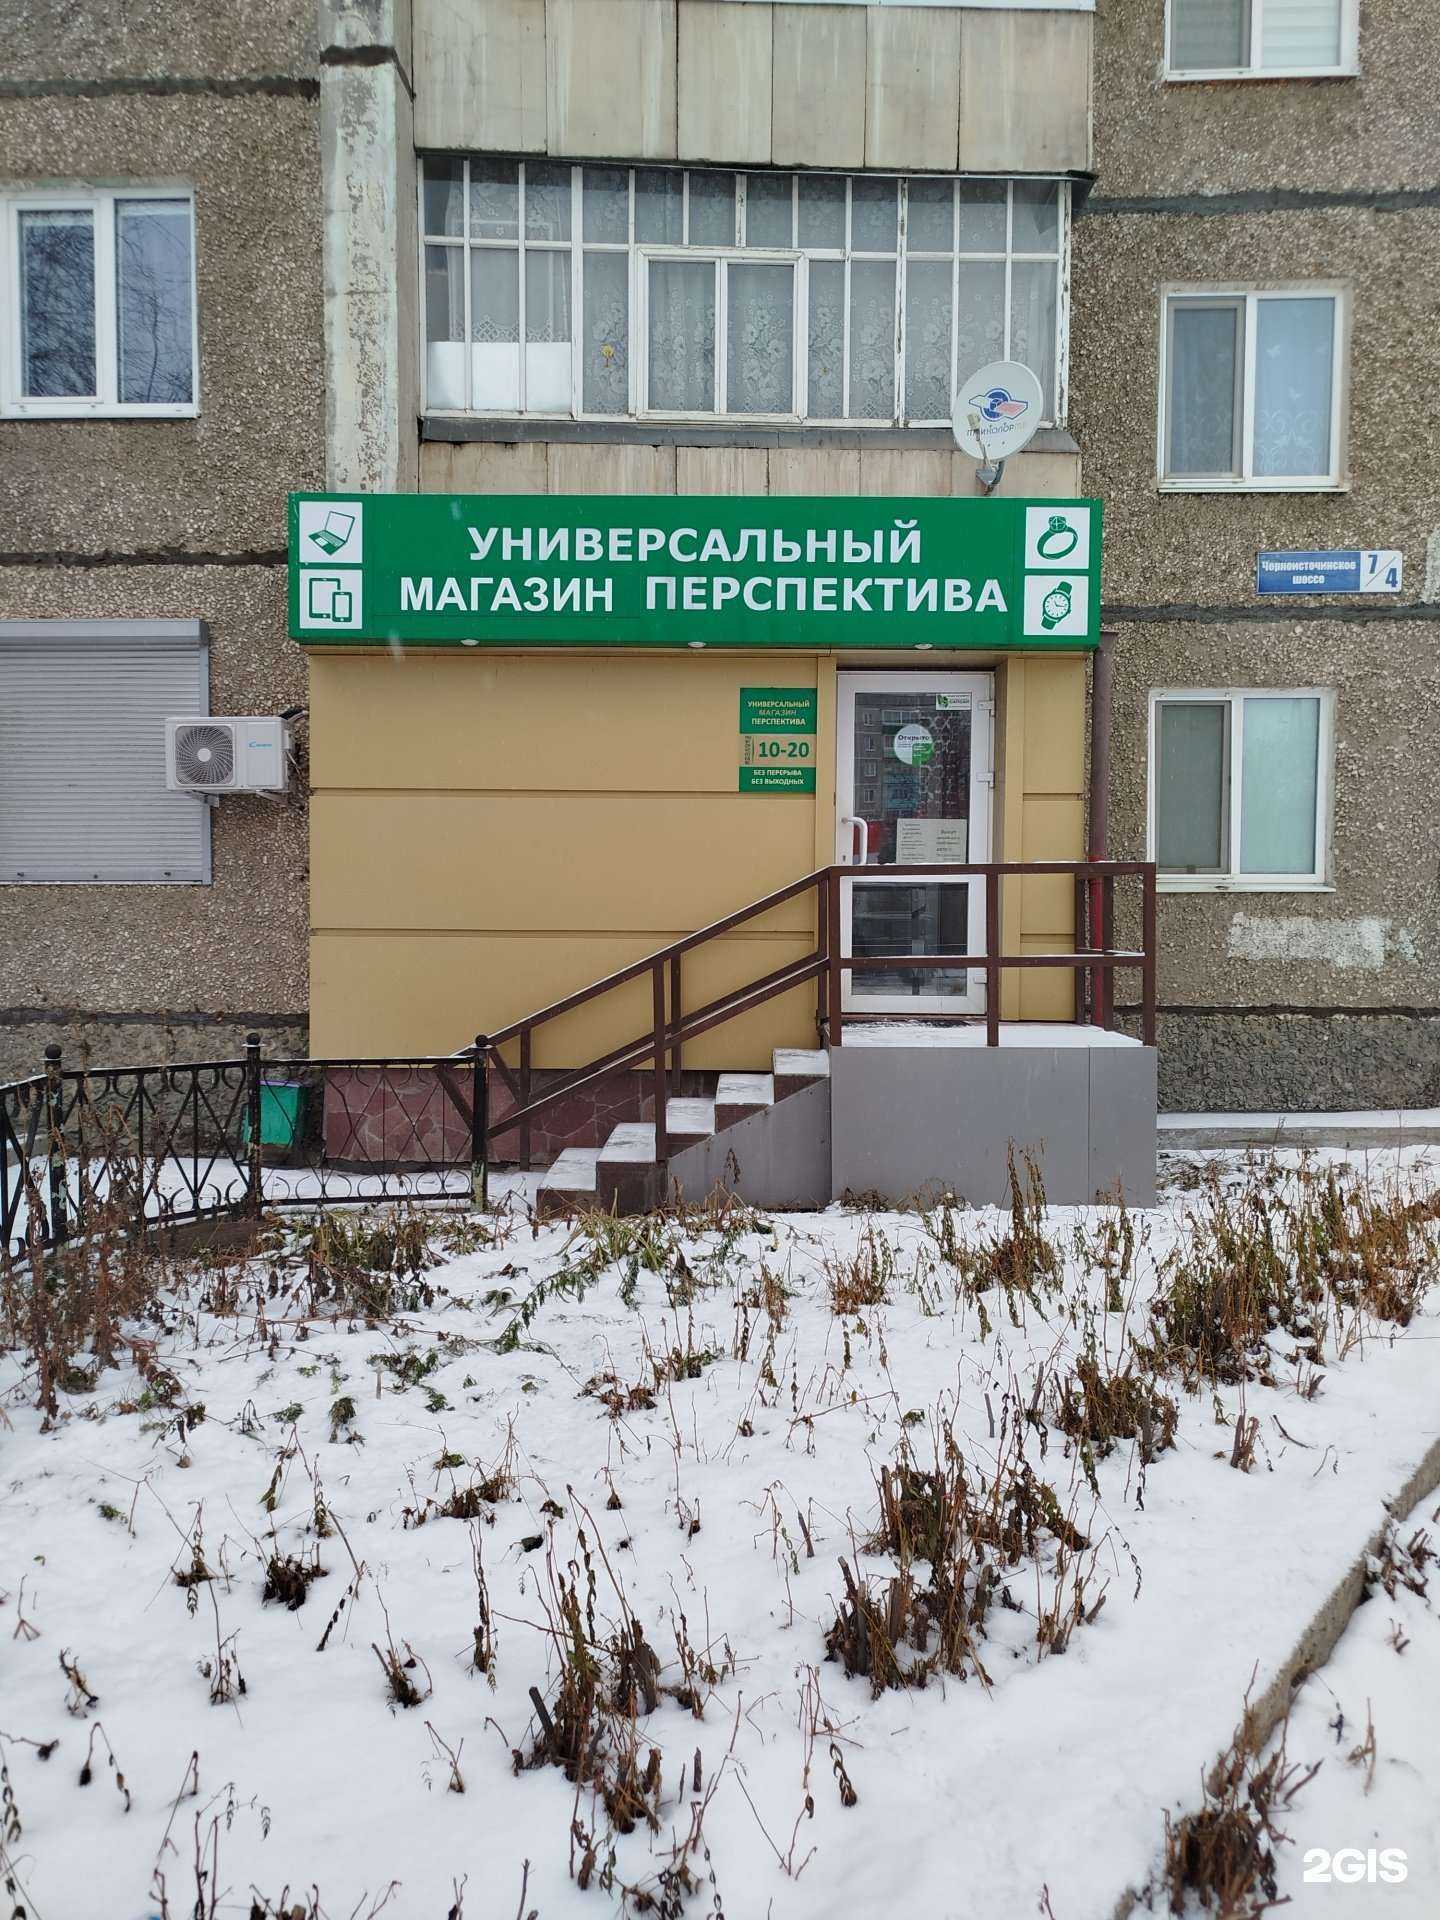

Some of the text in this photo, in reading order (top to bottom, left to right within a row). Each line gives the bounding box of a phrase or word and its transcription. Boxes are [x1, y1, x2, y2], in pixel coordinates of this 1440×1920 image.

[467, 519, 921, 563] УНИВЕРСАЛЬНЫЙ
[1262, 554, 1398, 588] Черноисточинское 7/4
[1292, 575, 1325, 585] шоссе
[400, 576, 1008, 612] МАГАЗИН ПЕРСПЕКТИВА
[747, 700, 810, 708] УНИВЕРСАЛЬНЫЙ
[751, 718, 806, 726] ПЕРСПЕКТИВА
[898, 734, 930, 742] Открыто
[758, 741, 810, 758] 10-20
[764, 778, 804, 786] ВЫХОДНЫХ
